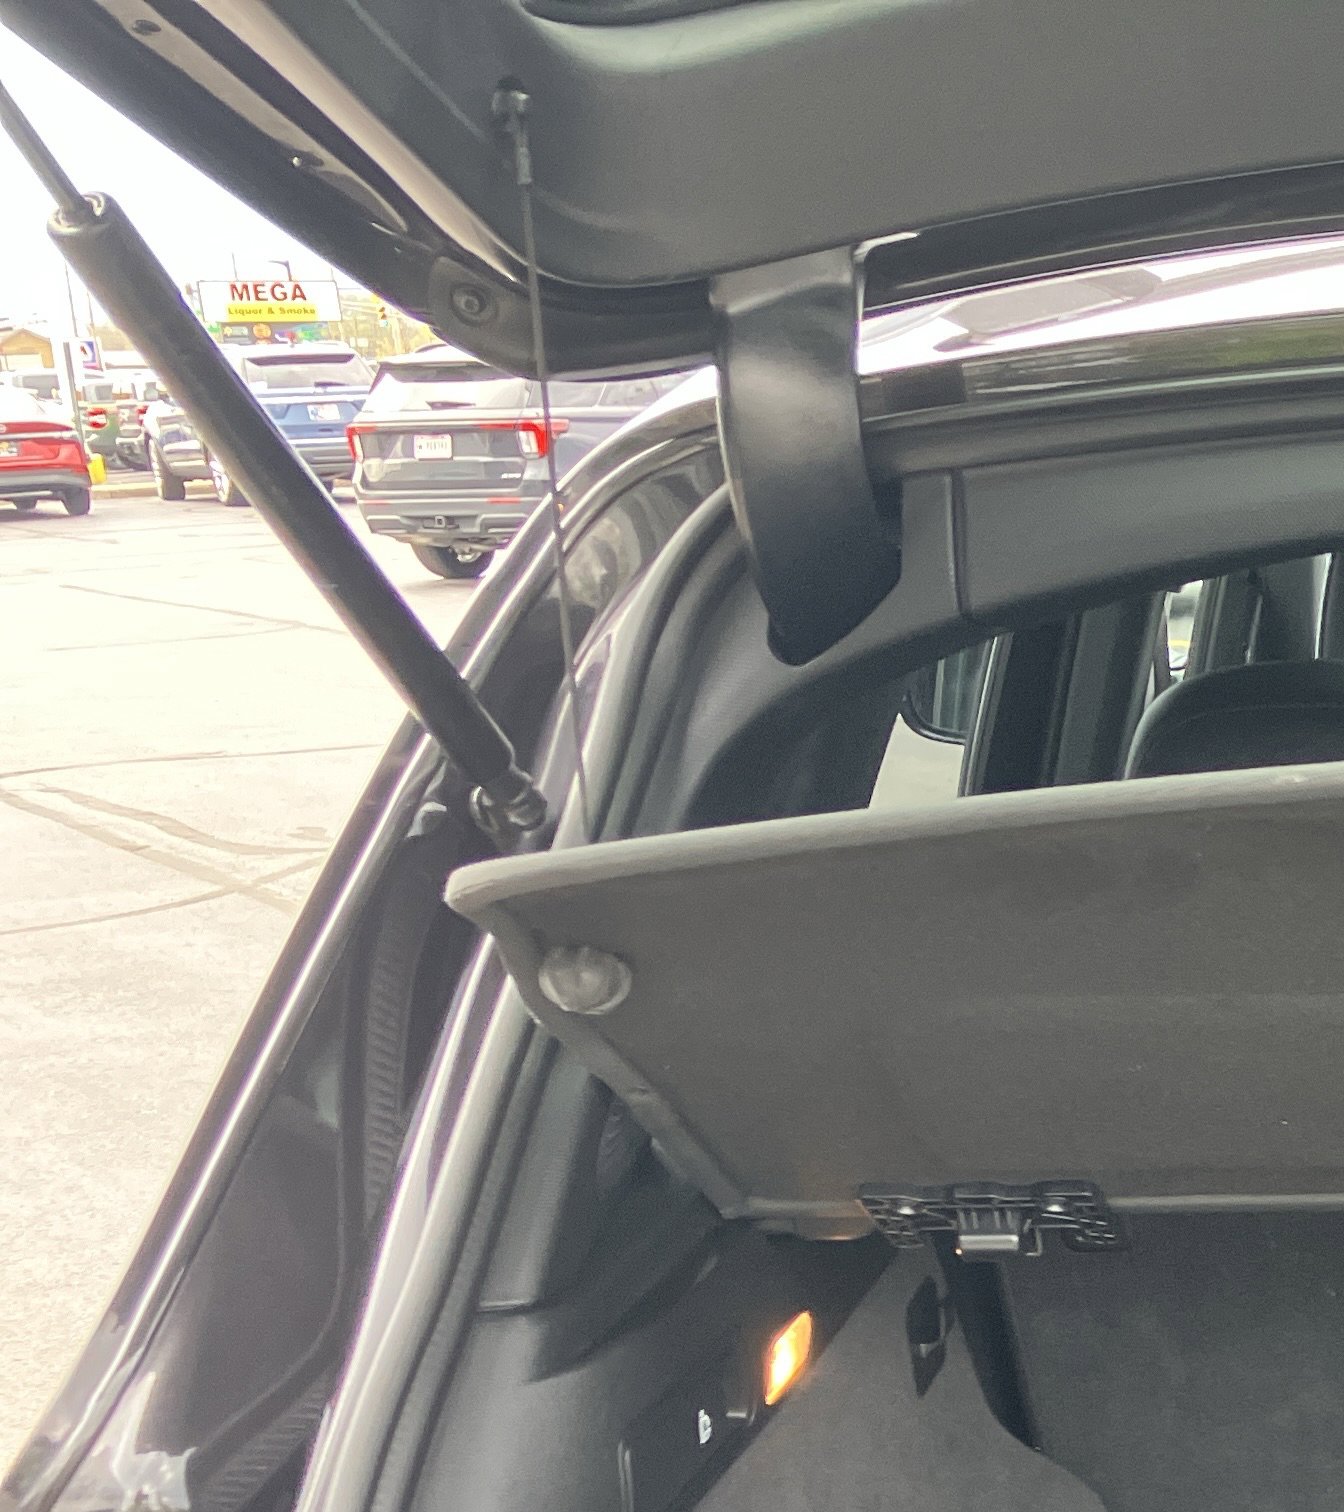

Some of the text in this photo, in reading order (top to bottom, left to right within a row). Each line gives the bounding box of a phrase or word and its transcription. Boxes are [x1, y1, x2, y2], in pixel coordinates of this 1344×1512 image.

[229, 282, 307, 302] MEGA
[228, 306, 316, 317] Liquor & Smoke
